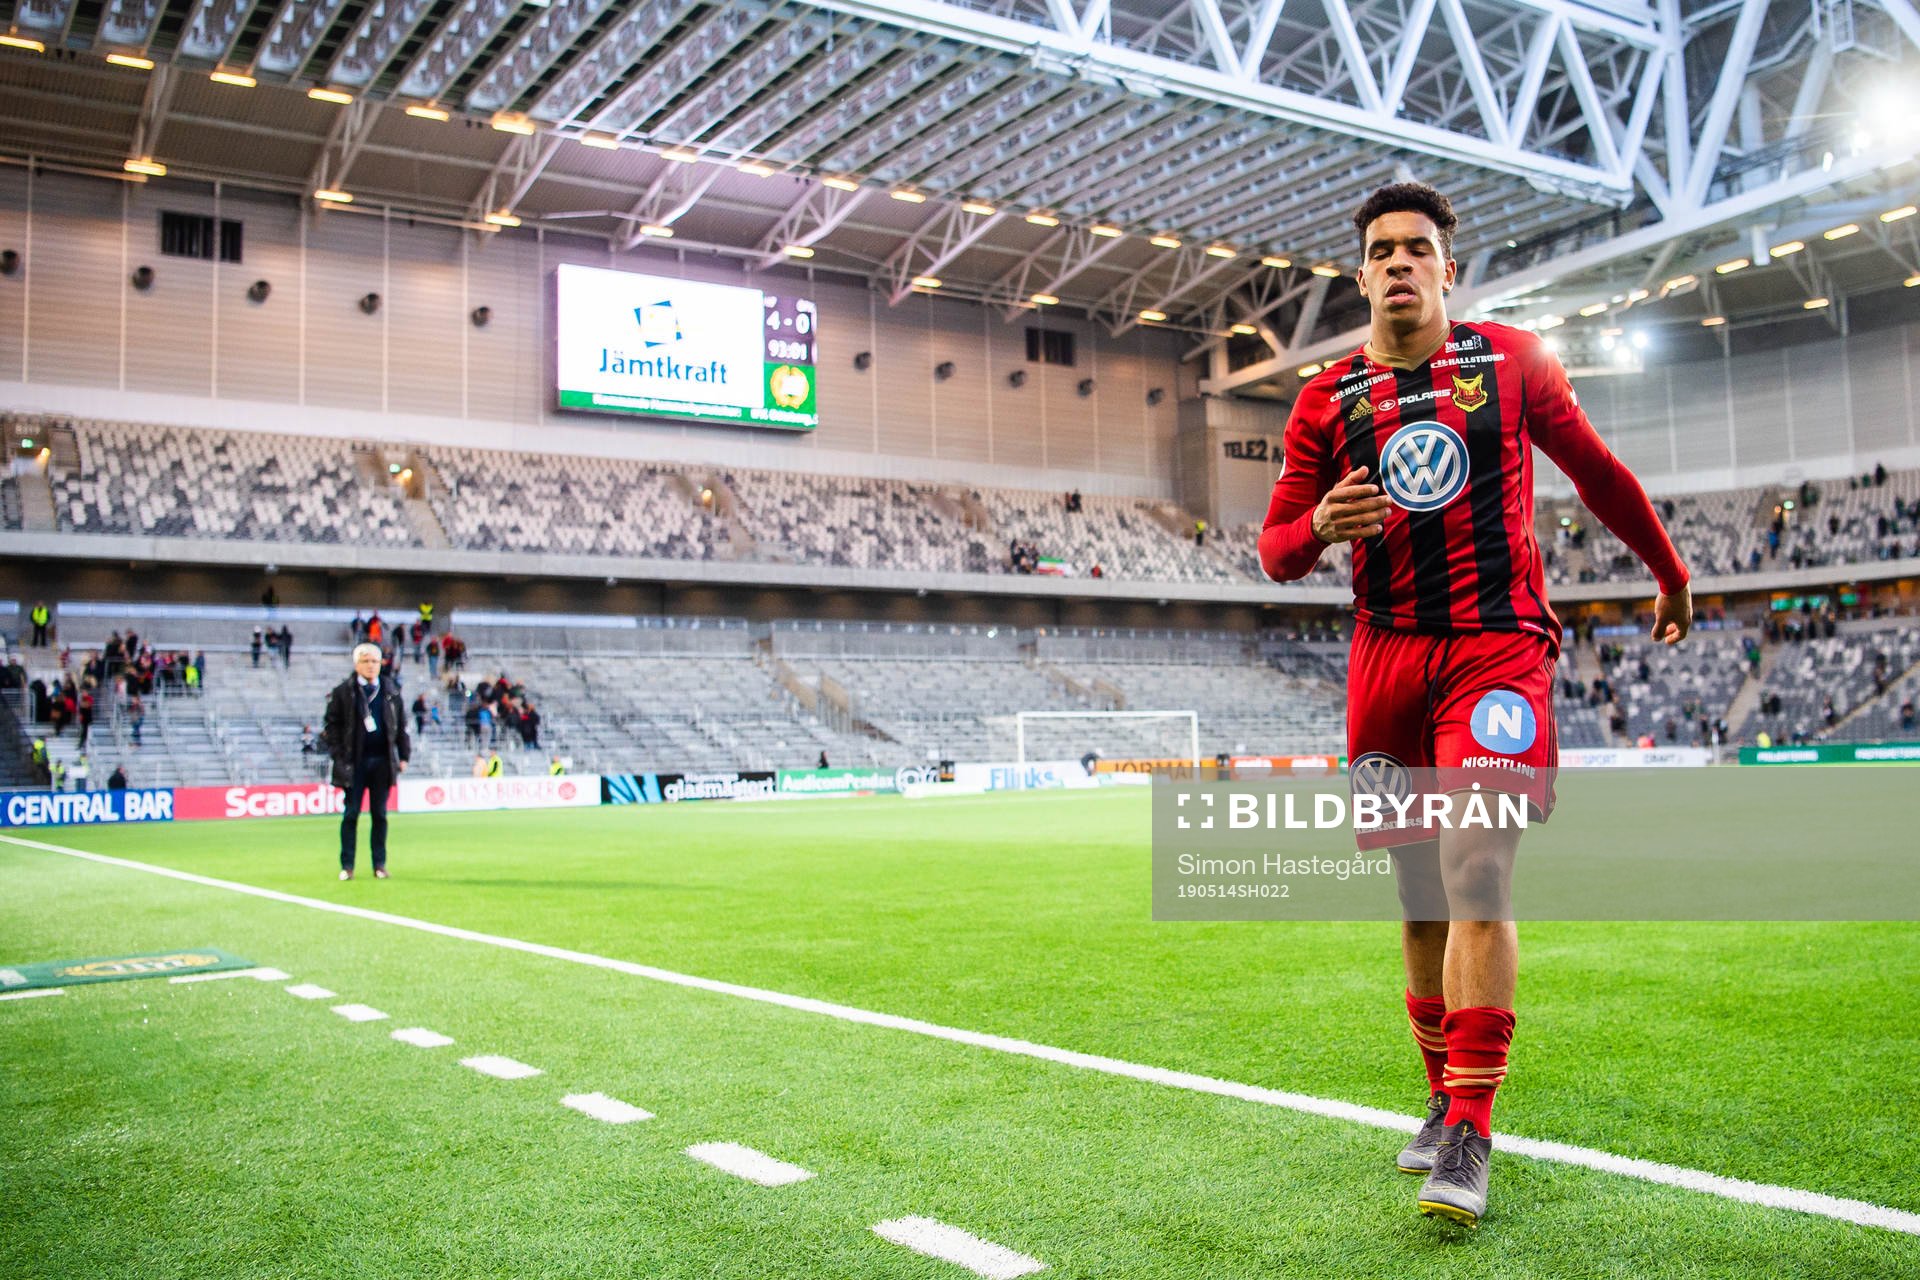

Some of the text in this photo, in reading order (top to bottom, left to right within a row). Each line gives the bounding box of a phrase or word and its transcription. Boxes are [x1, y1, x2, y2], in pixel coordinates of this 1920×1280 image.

[767, 311, 780, 330] 4
[796, 313, 810, 334] 0
[599, 348, 727, 384] Jämtkraft
[1398, 389, 1451, 406] POLARIS
[1349, 405, 1378, 422] adidas
[1223, 440, 1268, 462] TELE2
[1487, 703, 1522, 740] N
[1462, 756, 1536, 780] NIGHTLINE
[7, 790, 173, 825] CENTRAL BAR
